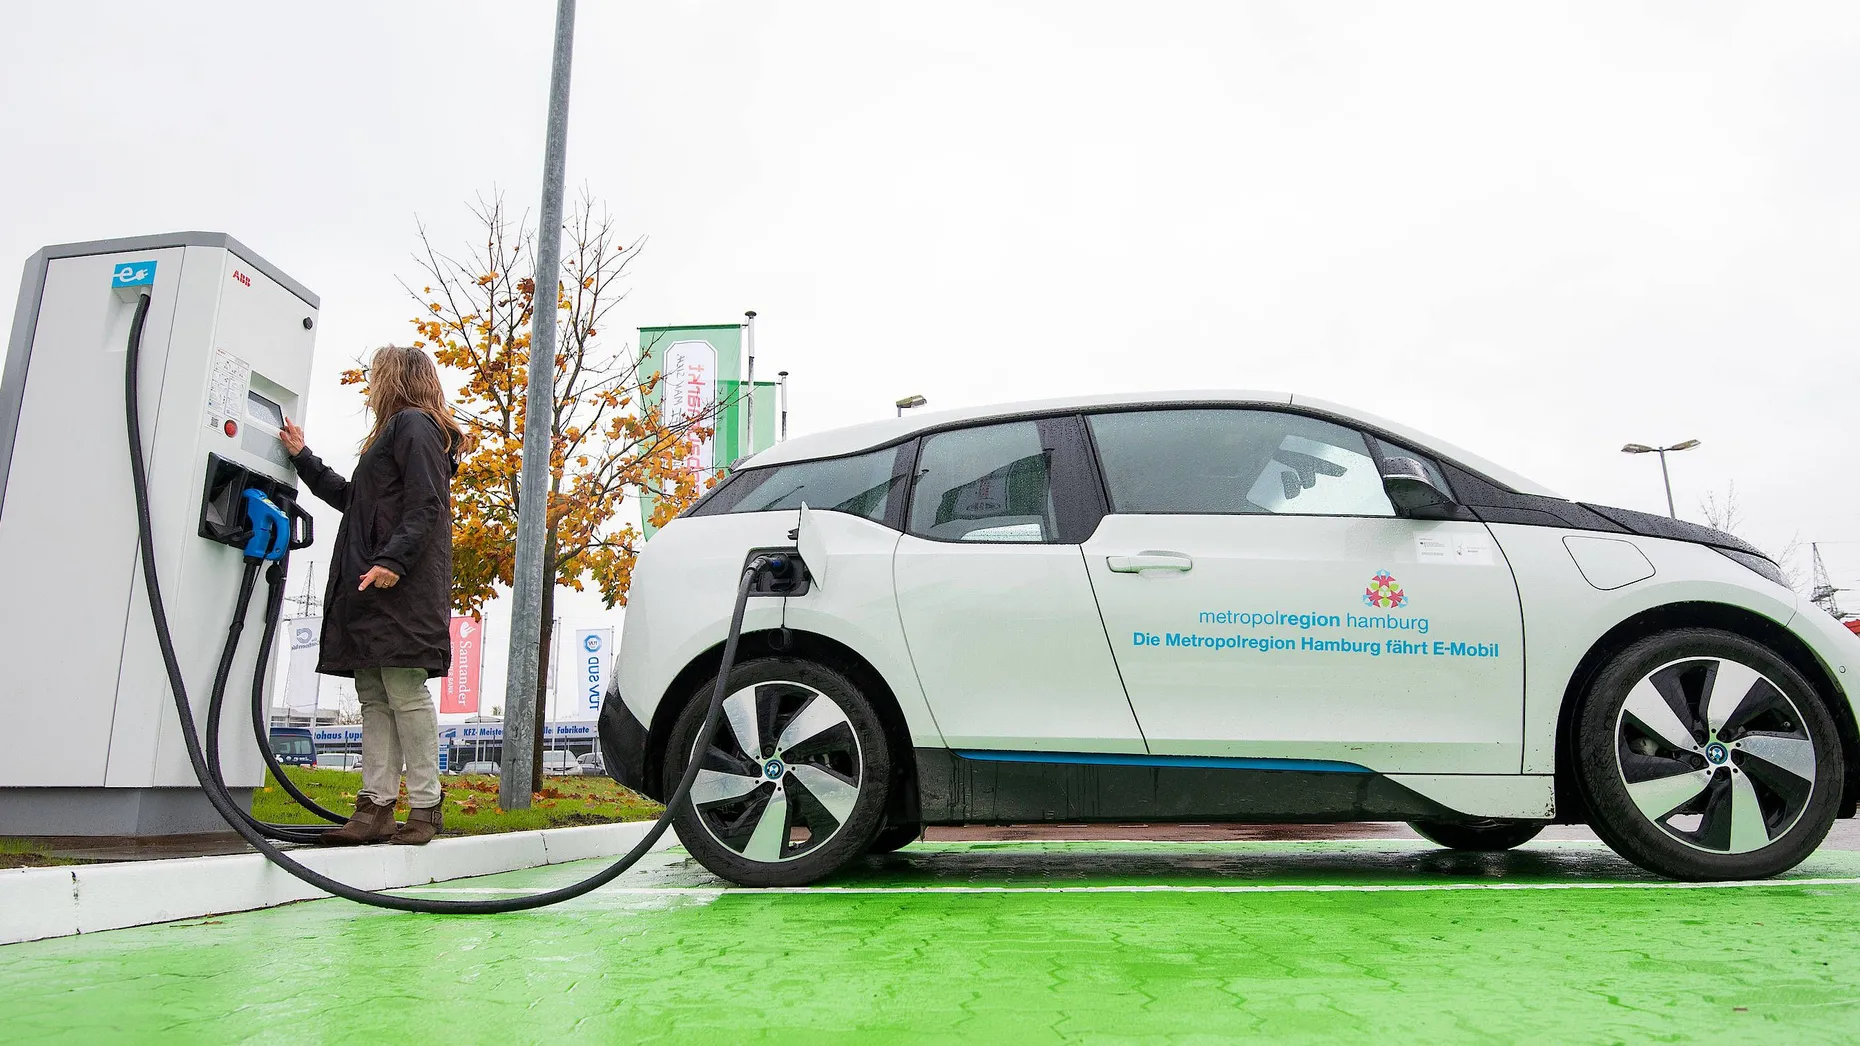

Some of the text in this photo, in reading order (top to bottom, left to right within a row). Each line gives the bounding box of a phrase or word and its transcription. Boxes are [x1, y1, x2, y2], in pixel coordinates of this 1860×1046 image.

[232, 270, 251, 287] ABB
[1199, 610, 1429, 634] metropolregion hamburg
[1133, 632, 1499, 657] Die Metropolregion Hamburg fährt E-Mobil
[458, 641, 472, 706] Santander
[557, 726, 590, 734] Fabrikate
